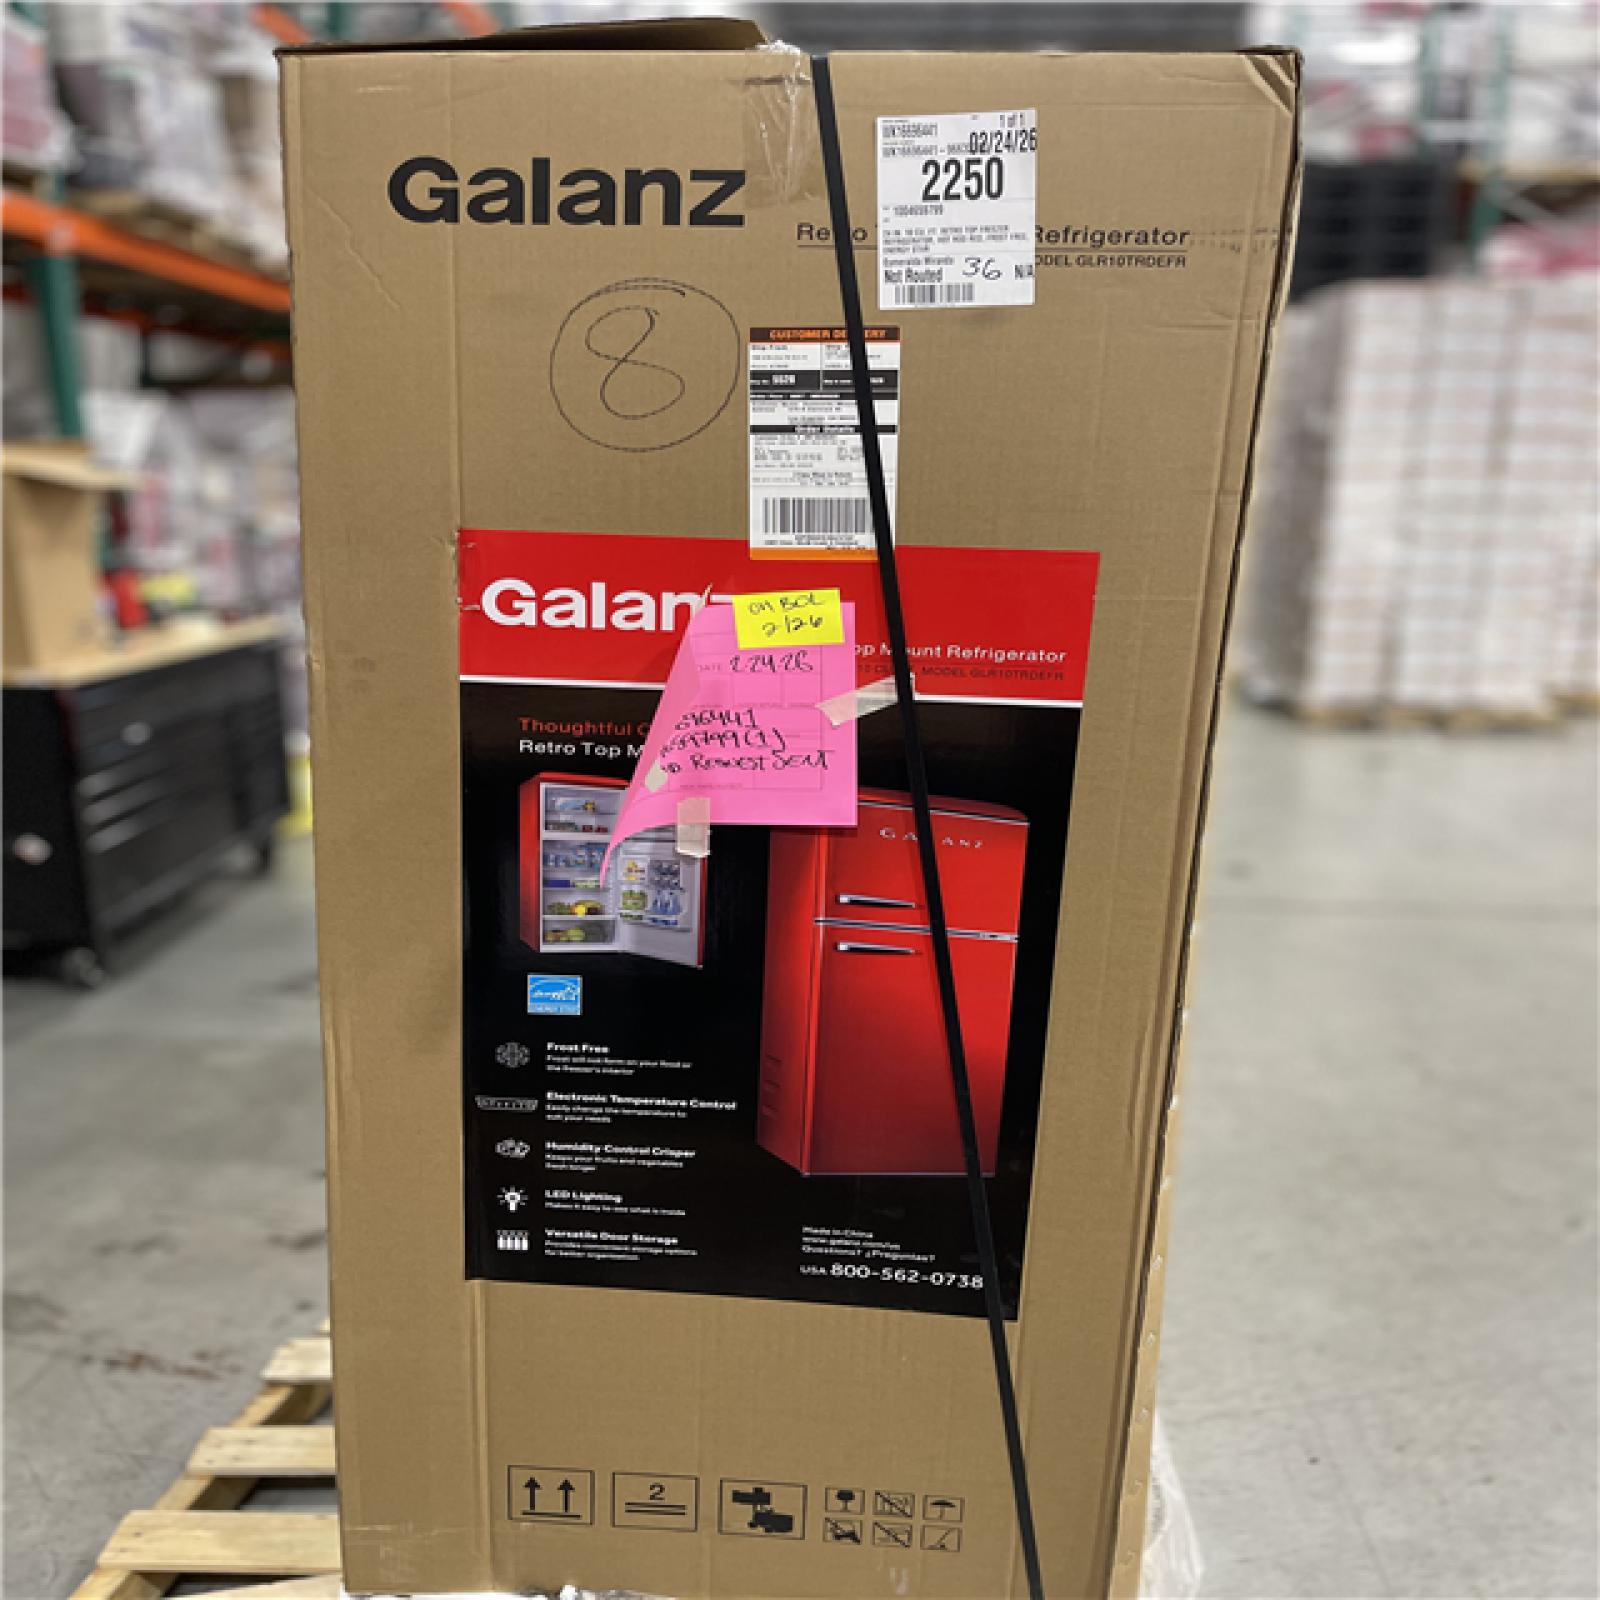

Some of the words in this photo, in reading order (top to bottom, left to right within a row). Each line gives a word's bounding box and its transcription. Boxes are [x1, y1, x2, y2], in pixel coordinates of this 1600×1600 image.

[921, 156, 1003, 202] 2250
[387, 155, 747, 227] Galanz
[796, 223, 869, 243] Reo
[962, 256, 1003, 281] 36
[585, 304, 686, 421] 8
[480, 577, 733, 632] Galan
[946, 644, 1068, 663] Refrigerator
[517, 716, 634, 737] Thoughtful
[519, 738, 576, 756] Retro
[580, 740, 621, 759] Top
[689, 1099, 738, 1111] Control
[829, 1262, 984, 1289] 800-562-0738
[649, 1483, 667, 1501] 2
